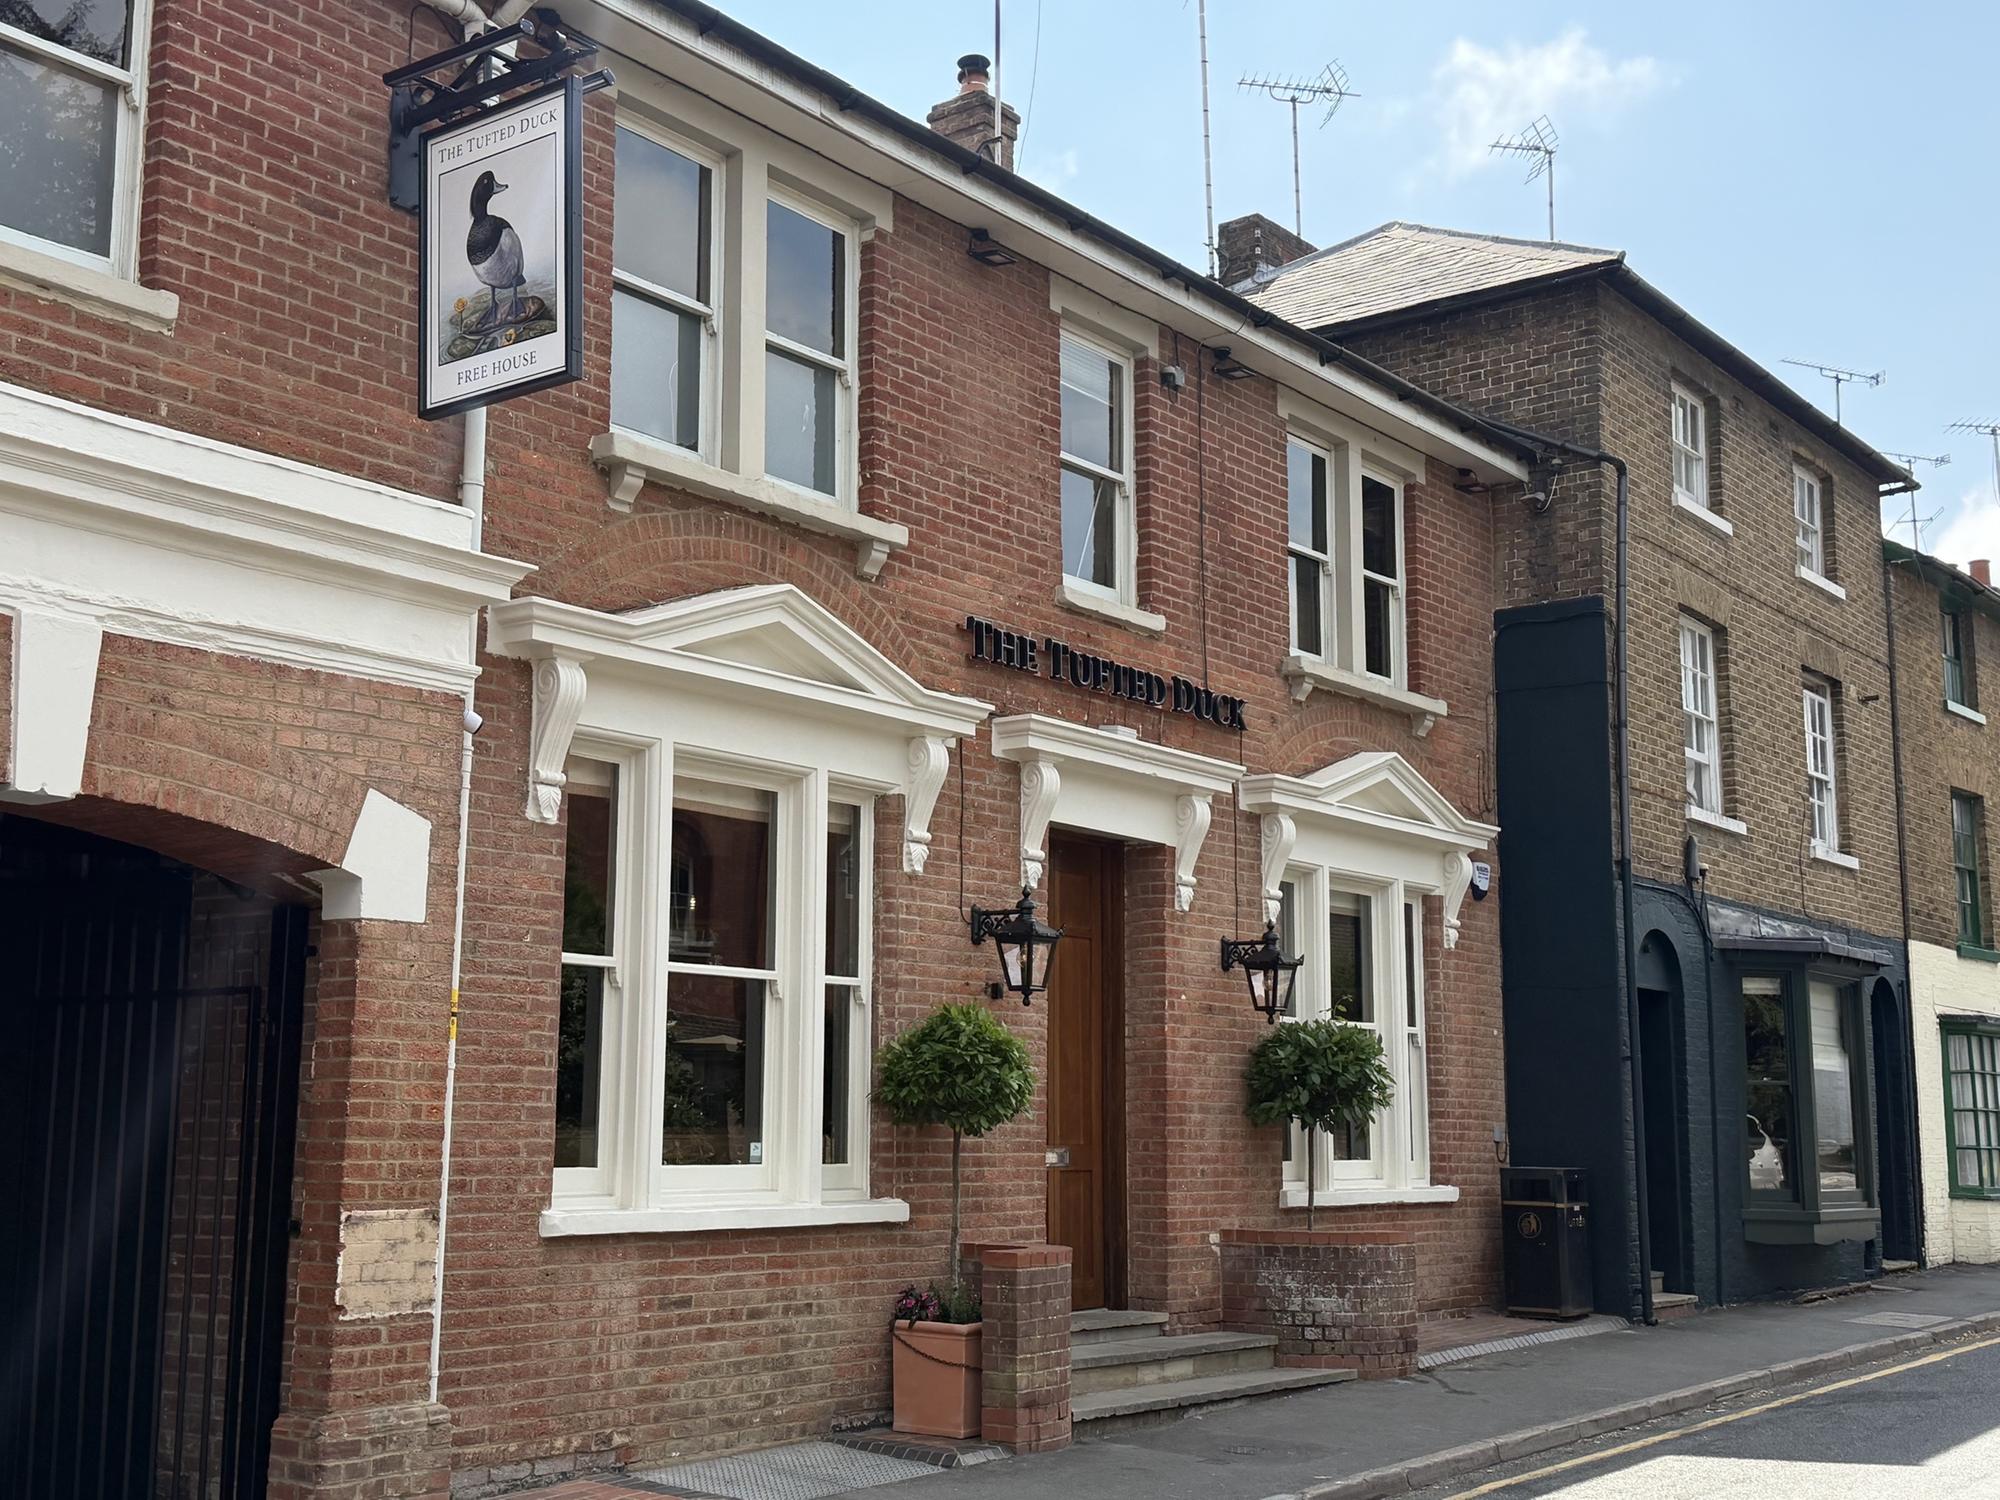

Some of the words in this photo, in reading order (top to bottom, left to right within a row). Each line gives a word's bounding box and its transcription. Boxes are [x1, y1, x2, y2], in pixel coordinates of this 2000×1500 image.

[438, 144, 463, 163] THE
[466, 125, 515, 152] TUFTED
[519, 108, 557, 133] DUCK
[457, 364, 488, 385] FREE
[492, 350, 537, 375] HOUSE
[966, 616, 1040, 674] THE
[1044, 638, 1168, 706] TUFTED
[1171, 675, 1248, 731] DUCK
